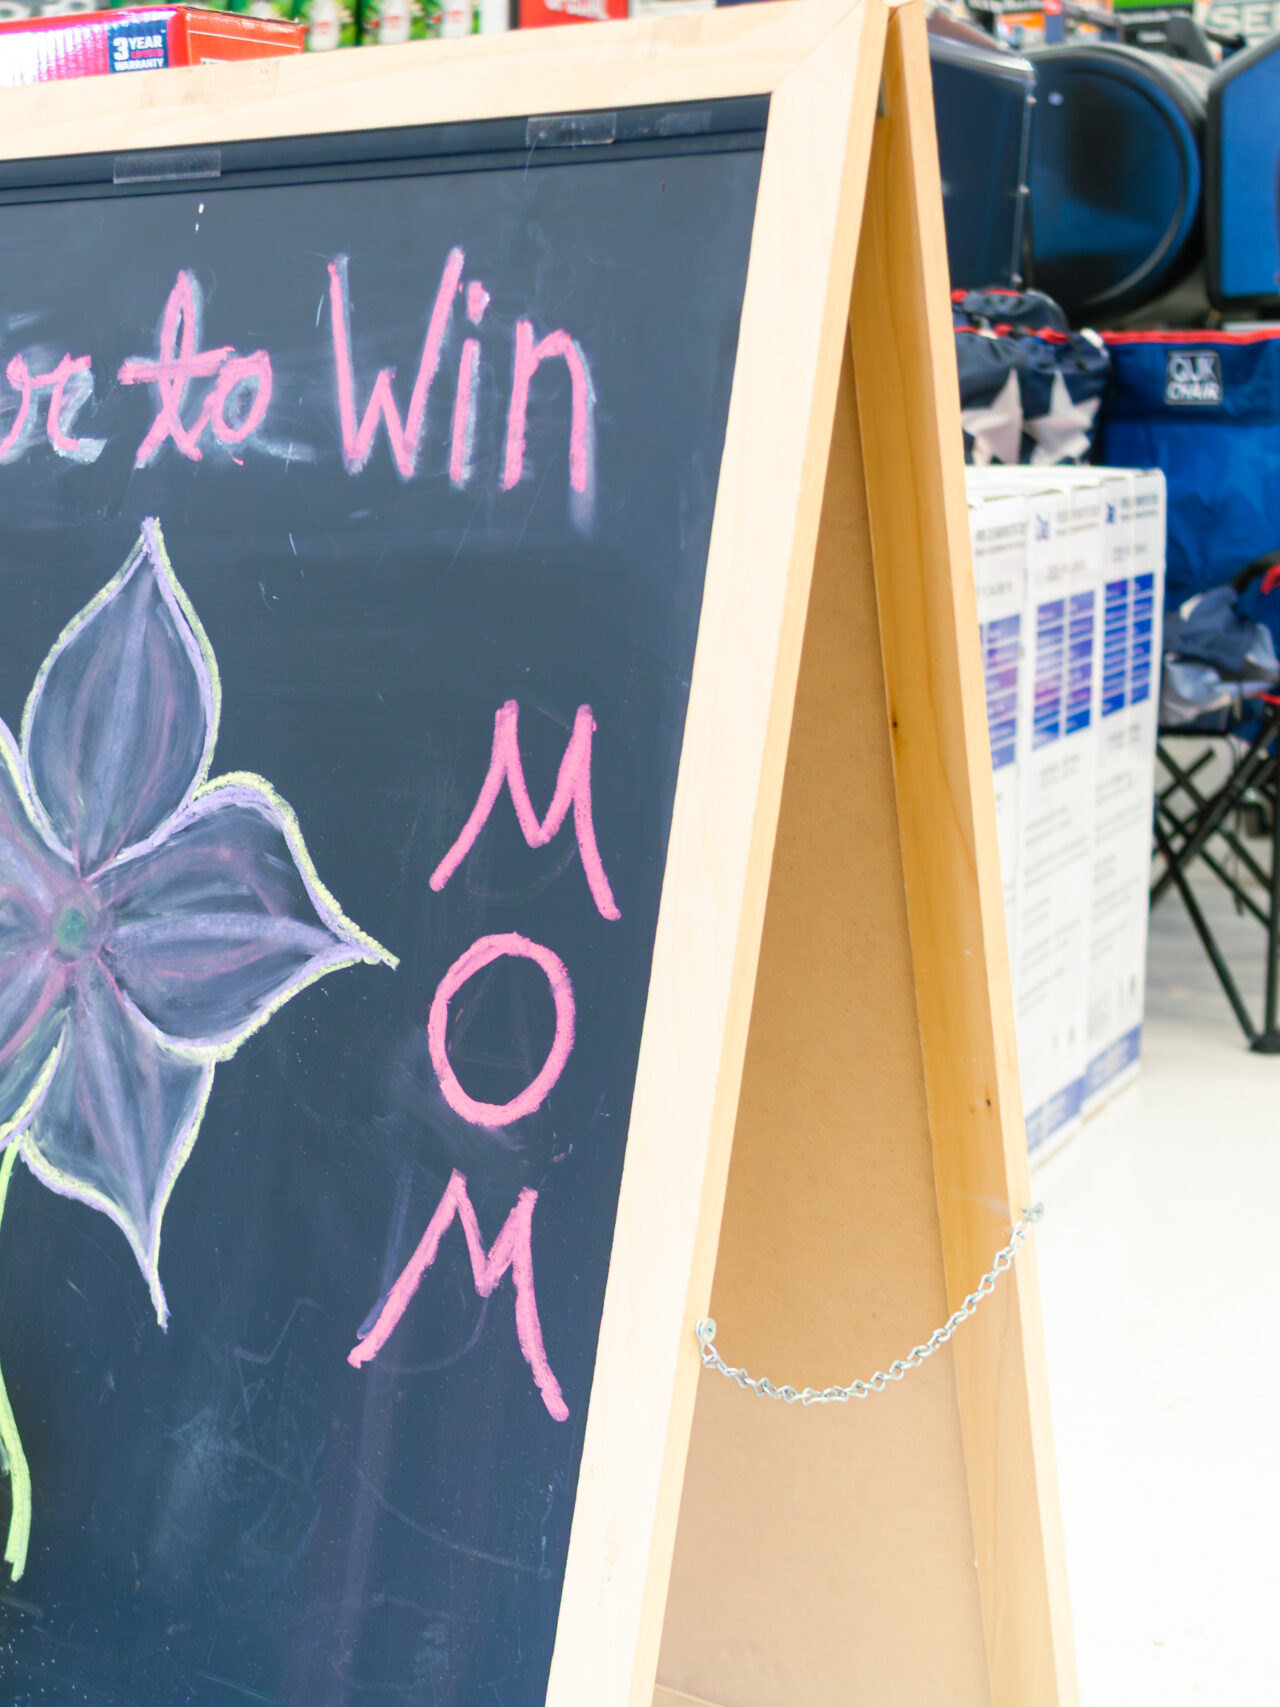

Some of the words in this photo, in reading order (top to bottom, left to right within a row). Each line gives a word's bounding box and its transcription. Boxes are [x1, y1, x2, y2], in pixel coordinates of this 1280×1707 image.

[113, 36, 130, 61] 3
[128, 34, 163, 52] YEAR
[118, 268, 273, 468] to
[328, 246, 597, 498] Win
[1168, 381, 1220, 401] CHAIR
[347, 699, 621, 1422] MOM
